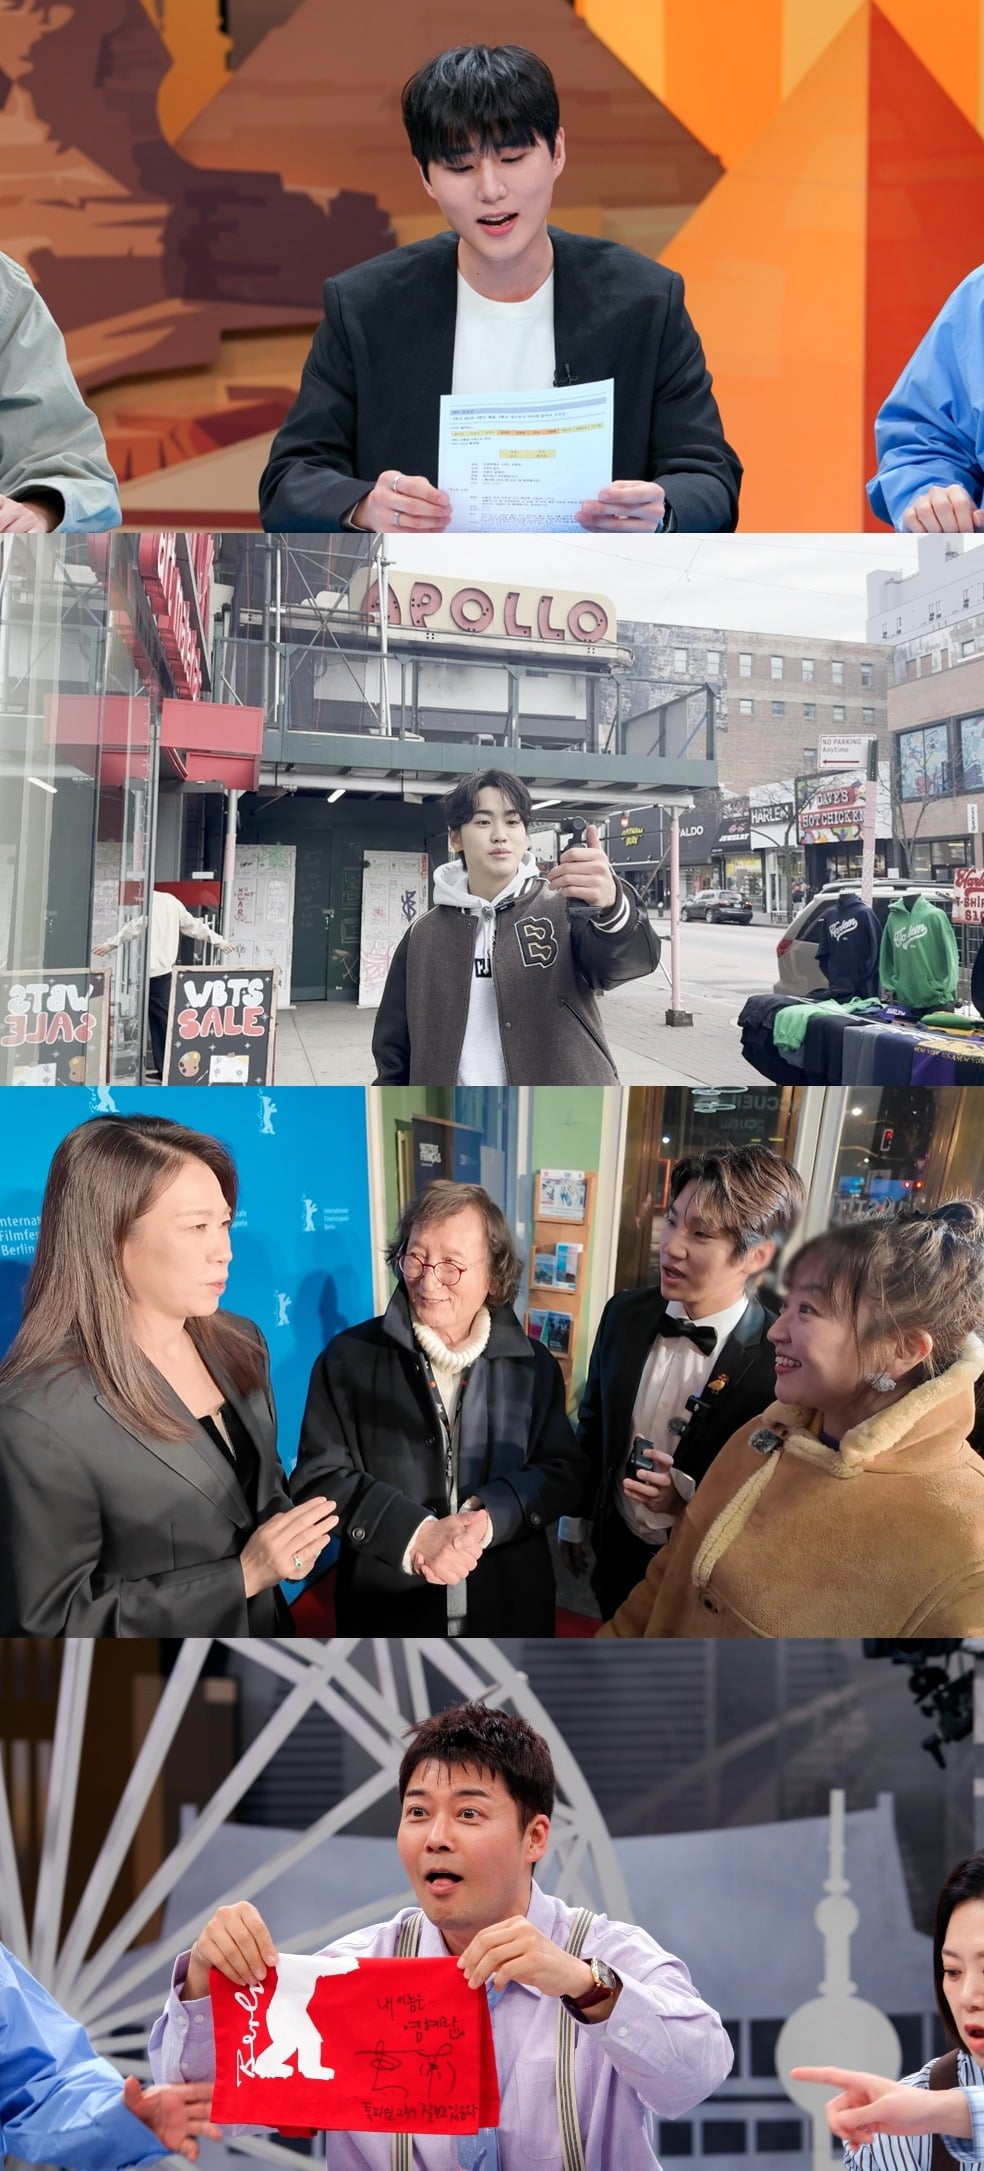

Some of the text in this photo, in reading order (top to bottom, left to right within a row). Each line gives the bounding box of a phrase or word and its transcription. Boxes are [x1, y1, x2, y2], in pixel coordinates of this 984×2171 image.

[361, 578, 609, 643] APOLLO
[817, 789, 849, 806] DAVE'S
[680, 826, 704, 837] ALDO
[515, 916, 559, 968] B
[893, 923, 928, 950] Halem
[183, 978, 265, 1008] WBTS
[177, 1005, 265, 1040] SALE
[0, 1216, 41, 1227] nternat
[1, 1243, 35, 1256] Berlin
[377, 1993, 424, 2020] 내 이름은
